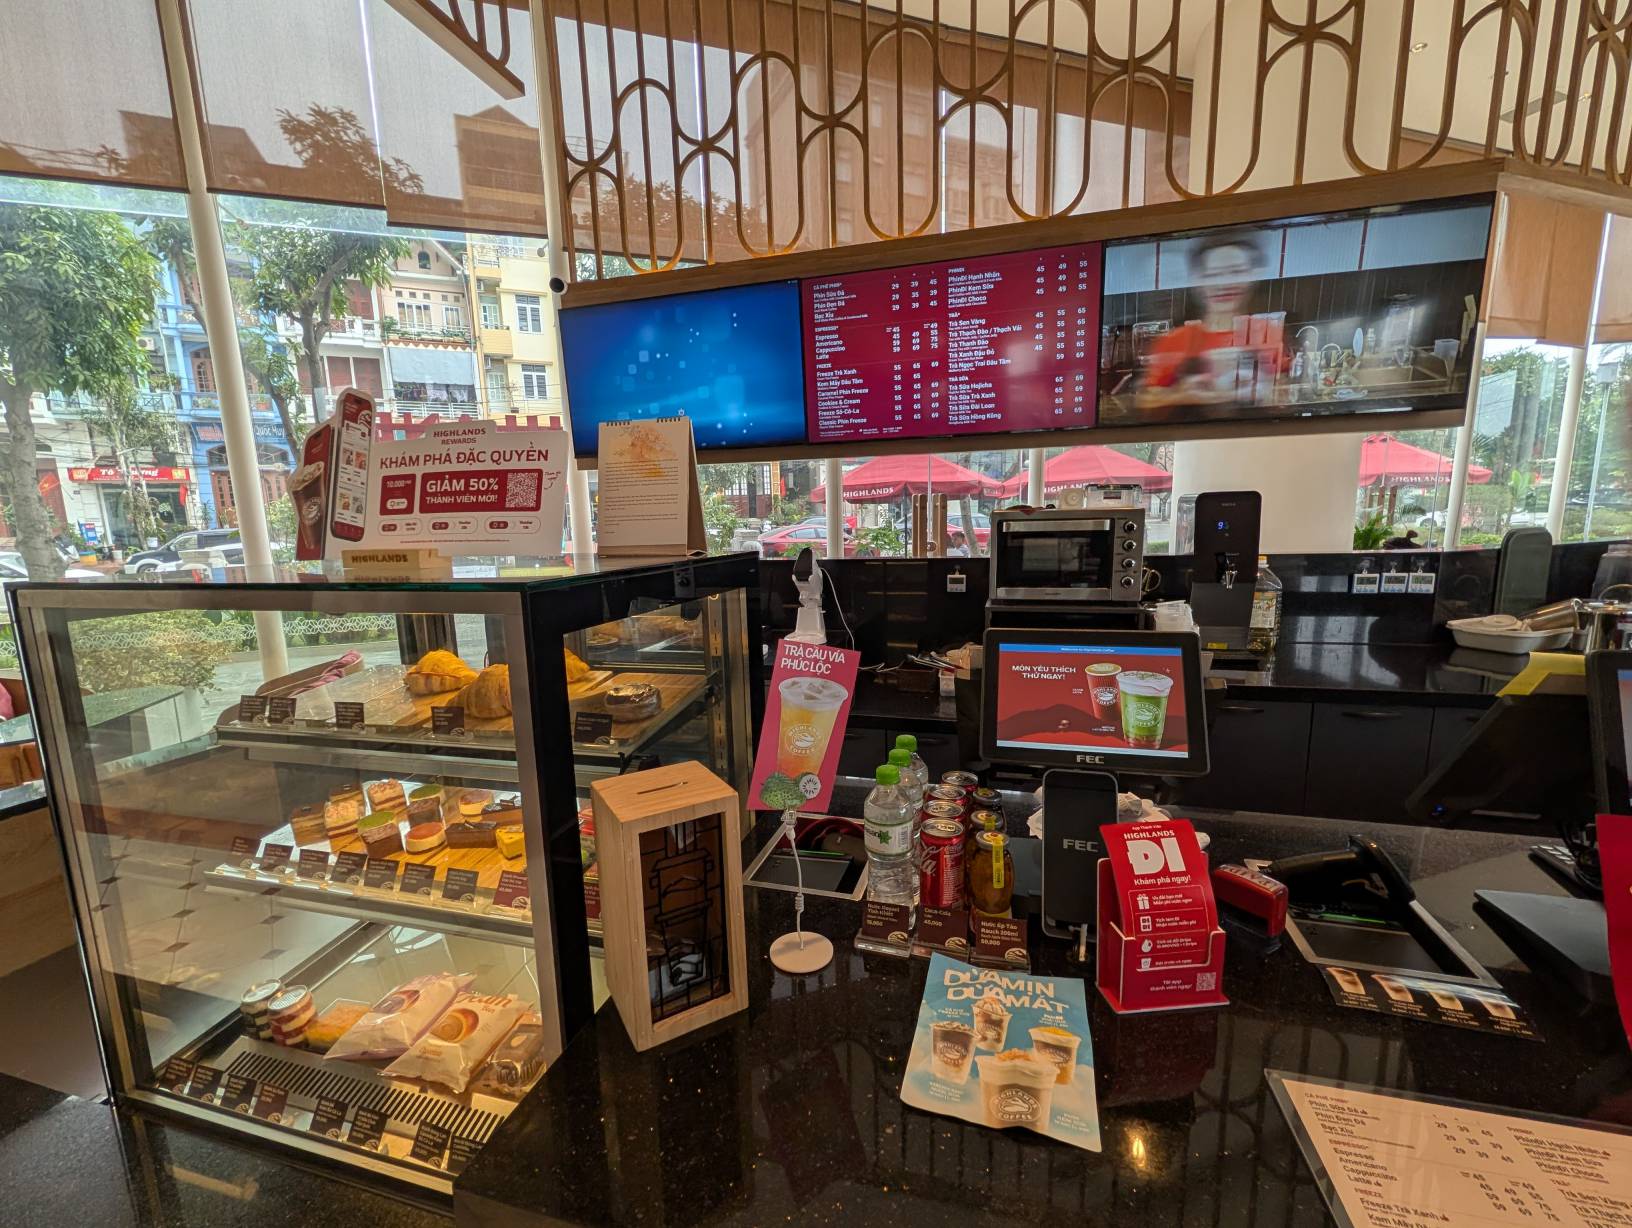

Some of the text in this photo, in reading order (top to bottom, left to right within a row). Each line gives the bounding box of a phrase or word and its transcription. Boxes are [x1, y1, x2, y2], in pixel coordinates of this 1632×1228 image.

[433, 427, 487, 438] HIGHLANDS
[440, 437, 477, 445] REWARDS
[380, 441, 549, 469] KHÁM PHÁ ĐẶC QUYỀN
[426, 474, 465, 493] GIẢM
[468, 477, 499, 491] 50%
[425, 493, 498, 504] THÀNH VIÊN MỚI!
[843, 486, 894, 498] HIGHLANDS
[351, 554, 409, 564] HIGHLANDS
[784, 643, 845, 664] TRÀ CẦU VÍA
[780, 657, 832, 675] PHÚC LỘC
[1012, 664, 1077, 673] MÓN YÊU THÍCH
[1022, 671, 1066, 680] THỬ NGAY!
[1076, 754, 1105, 764] FEC
[1123, 829, 1175, 840] HIGHLANDS
[1063, 838, 1099, 852] FEC
[1134, 874, 1192, 886] Khám phá ngay!
[1001, 977, 1055, 998] MỊN
[1005, 995, 1070, 1013] MÁT
[1333, 1147, 1375, 1161] Espresso
[1338, 1156, 1388, 1172] Americano
[1342, 1165, 1398, 1182] Cappuccino
[1347, 1174, 1373, 1186] Latte
[1359, 1197, 1393, 1210] Freeze
[1411, 1208, 1440, 1221] Xanh
